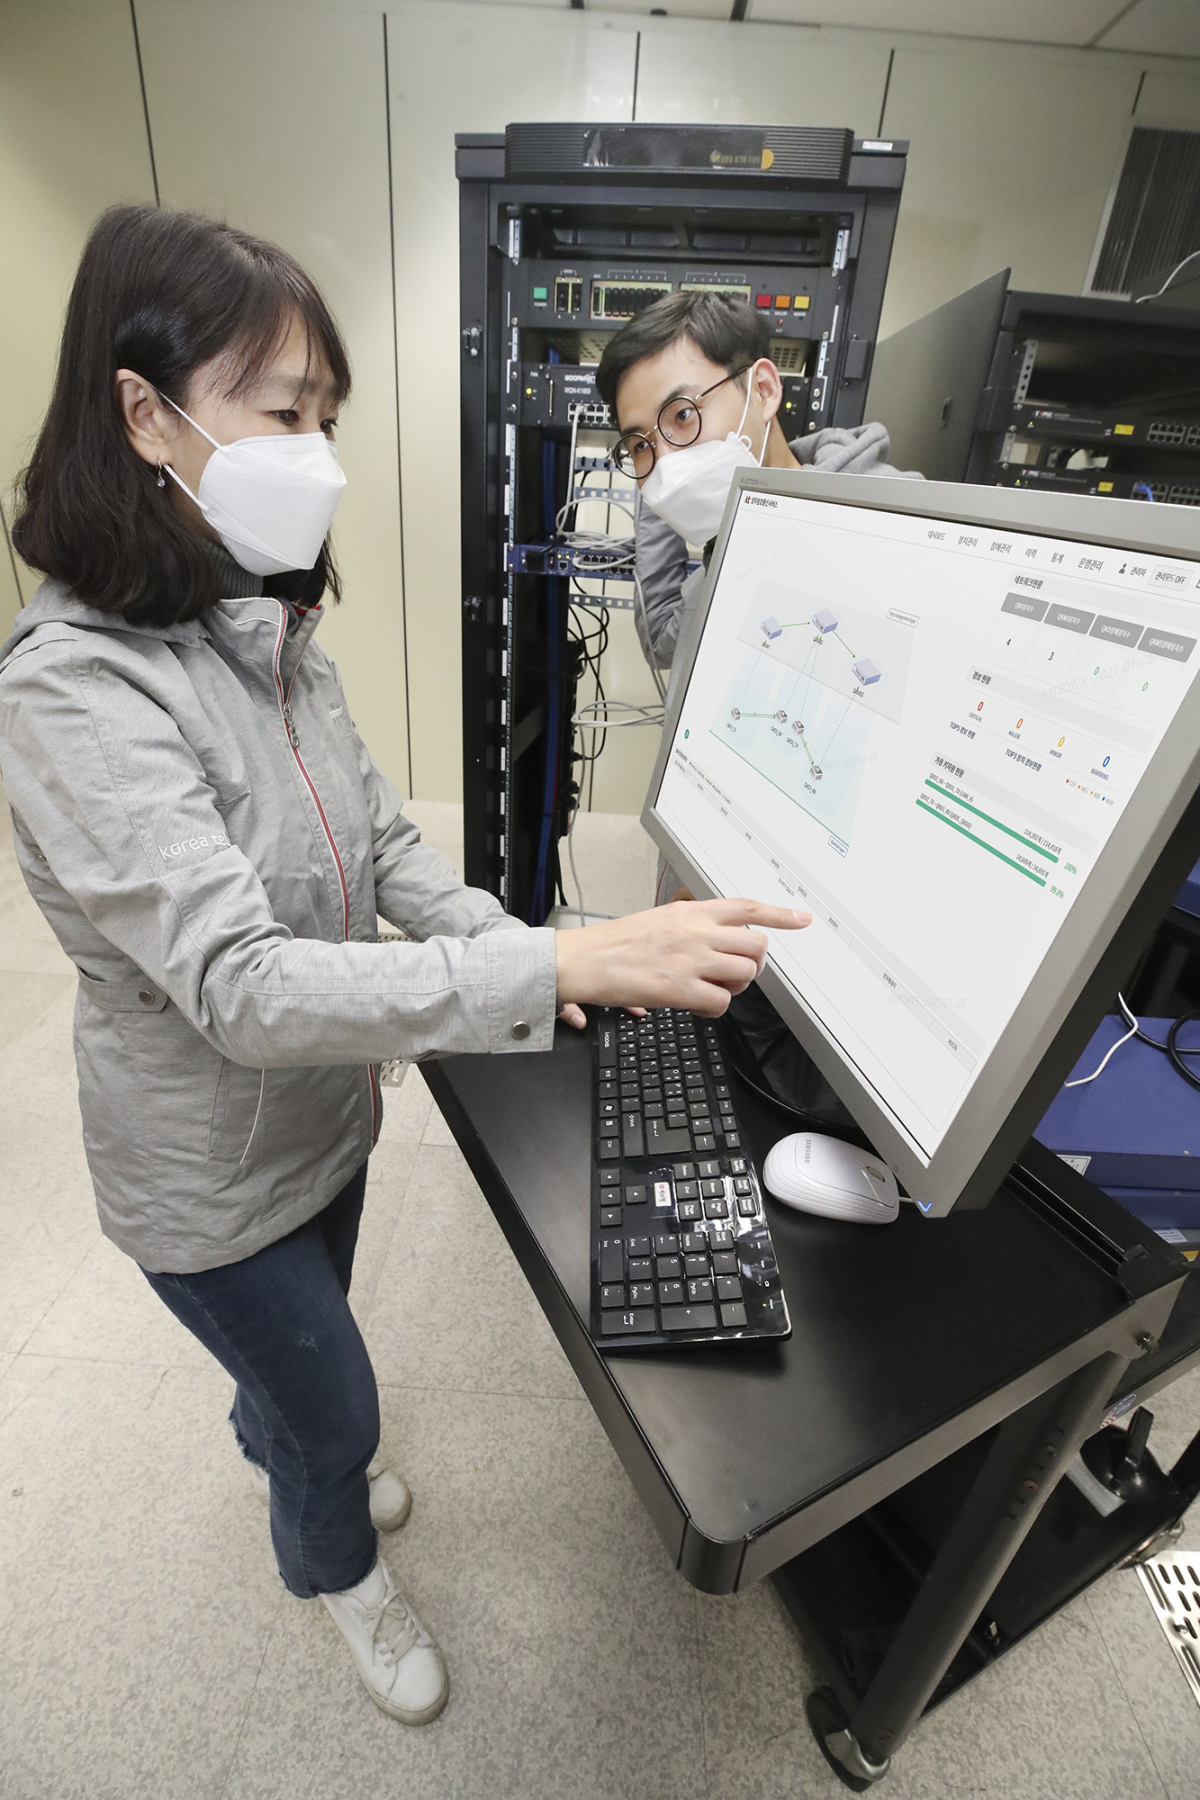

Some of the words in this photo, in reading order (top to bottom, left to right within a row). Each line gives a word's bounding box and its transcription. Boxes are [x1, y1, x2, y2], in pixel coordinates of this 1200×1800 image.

[1024, 547, 1038, 558] 이력
[1049, 551, 1065, 563] 통계
[1077, 556, 1105, 571] 운영관리
[1129, 565, 1148, 577] 관리자
[1173, 574, 1187, 585] OFF
[1006, 637, 1012, 645] 4
[1048, 651, 1055, 660] 3
[1093, 666, 1100, 675] 0
[981, 674, 992, 685] 현황
[1141, 681, 1149, 691] 0
[977, 700, 984, 711] 0
[1015, 717, 1024, 729] 0
[1008, 729, 1021, 739] MAJOR
[1057, 735, 1066, 747] 0
[1005, 747, 1017, 758] TOP3
[1016, 753, 1026, 762] 장치
[1049, 748, 1062, 758] MINOR
[1102, 754, 1111, 766] 0
[955, 766, 965, 777] 현황
[1091, 767, 1109, 779] WARNING
[158, 836, 208, 860] korea
[1064, 861, 1078, 873] 100%
[1050, 884, 1065, 897] 99.8%
